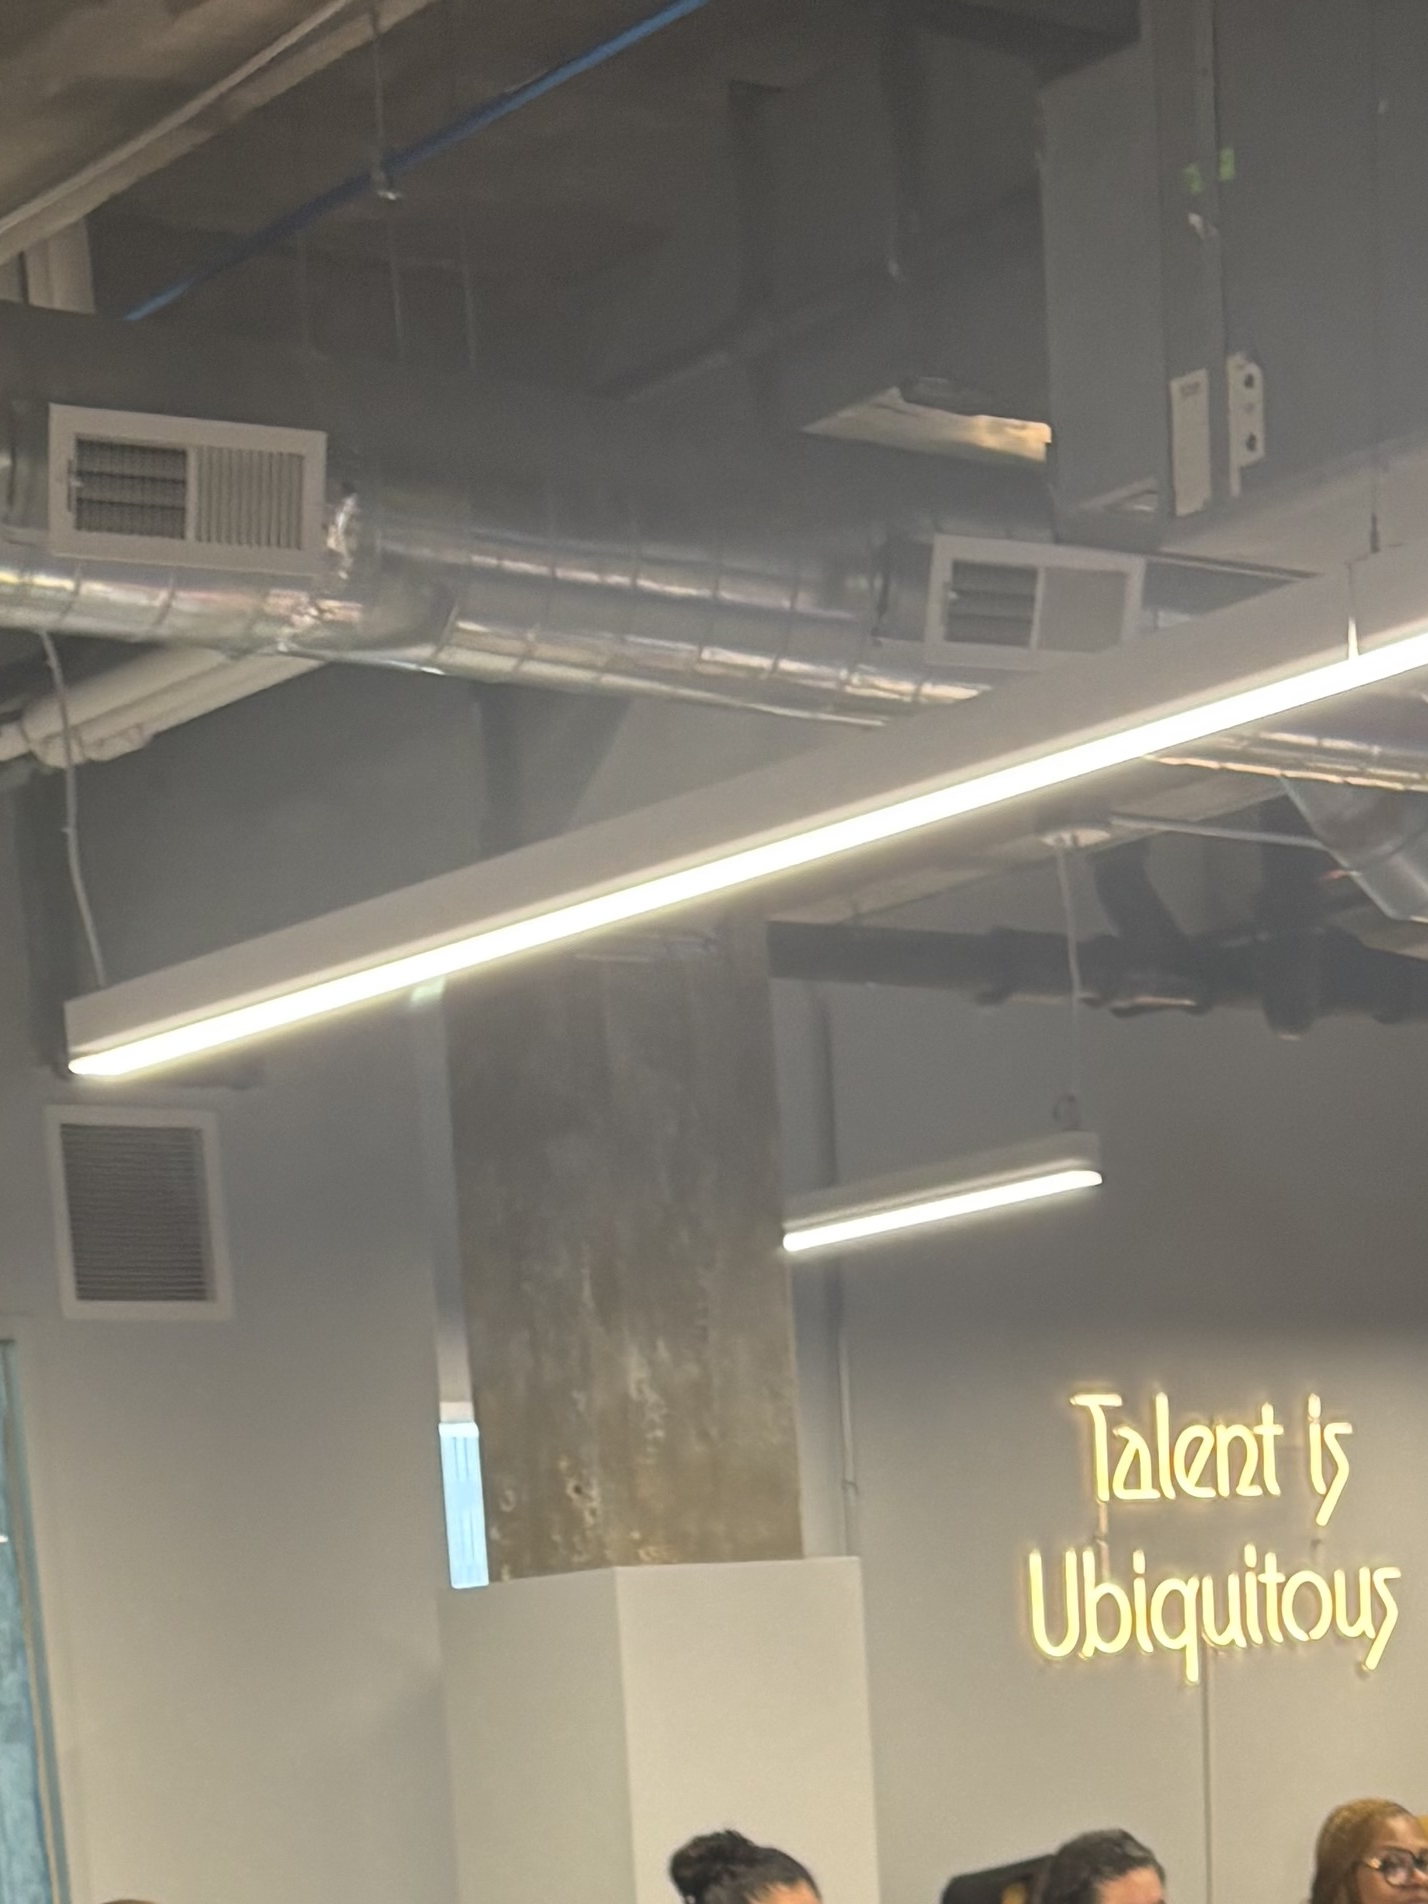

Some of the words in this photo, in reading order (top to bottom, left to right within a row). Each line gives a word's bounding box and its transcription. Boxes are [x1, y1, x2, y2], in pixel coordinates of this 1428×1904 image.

[1069, 1391, 1284, 1501] Talent
[1307, 1392, 1353, 1527] is
[1028, 1543, 1402, 1684] Ubiquitous
